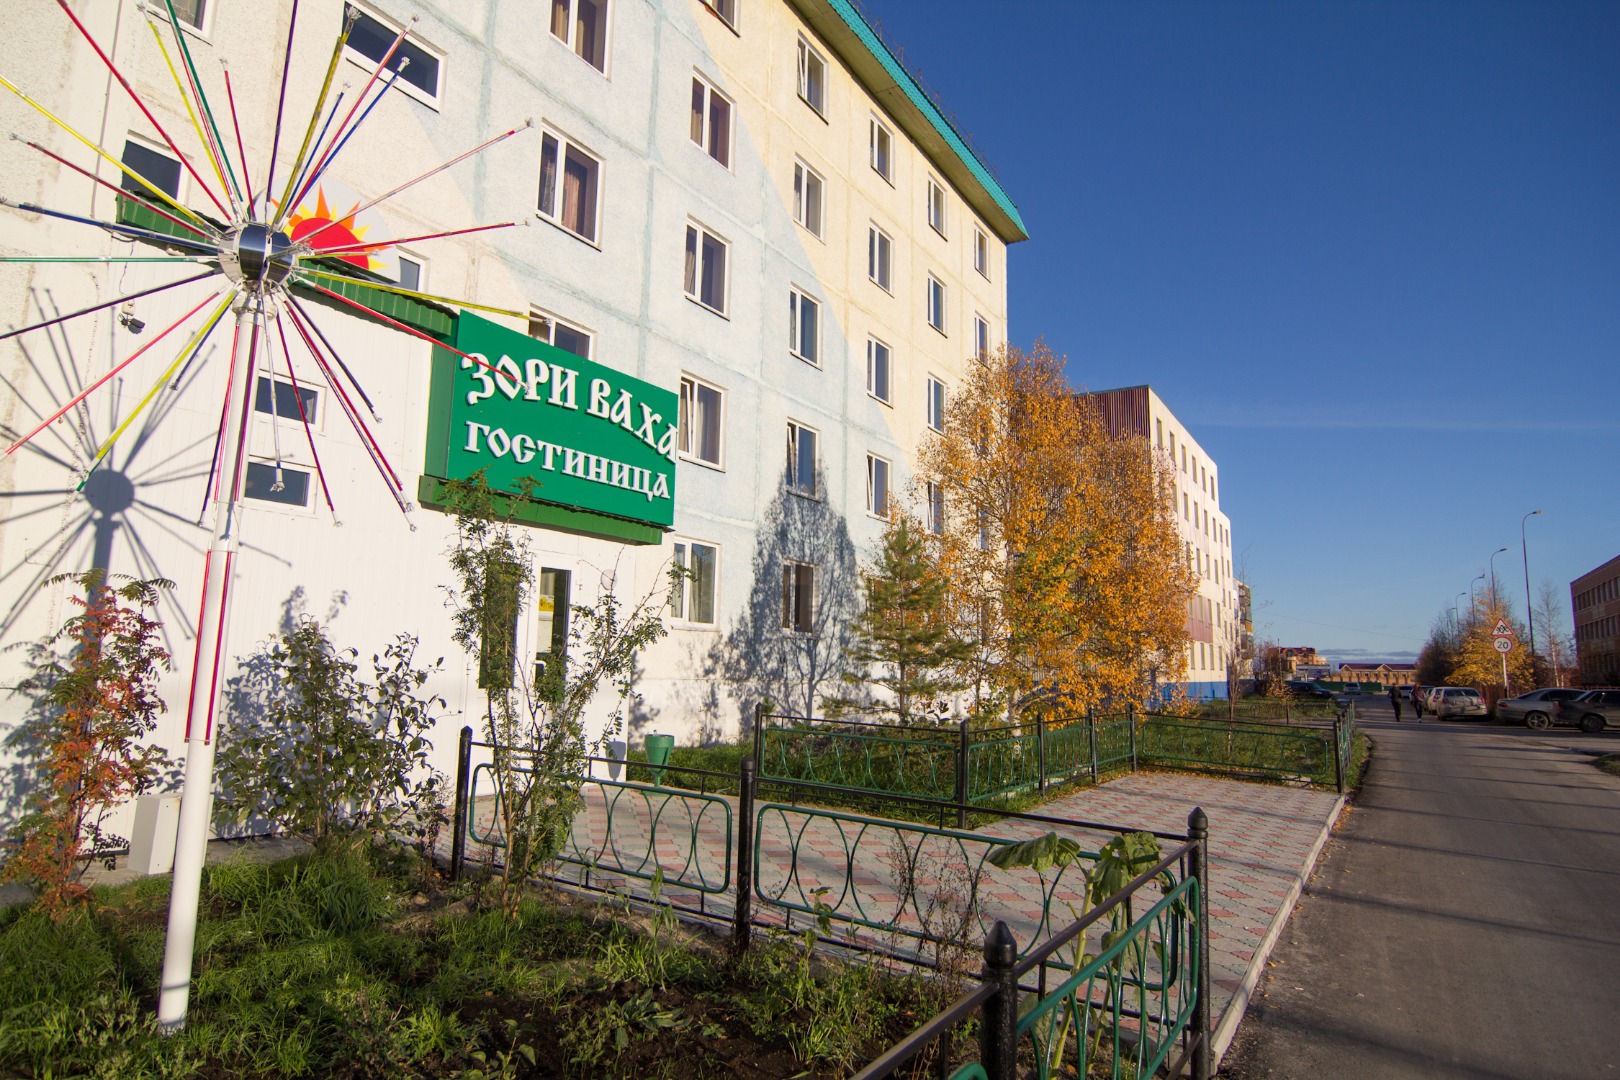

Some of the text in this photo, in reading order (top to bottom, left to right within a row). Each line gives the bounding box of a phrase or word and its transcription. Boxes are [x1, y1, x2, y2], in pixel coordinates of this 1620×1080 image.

[461, 352, 679, 464] ЗОРИ ВАХА
[463, 421, 671, 502] ГОСТИНИЦА
[1497, 641, 1509, 649] 20
